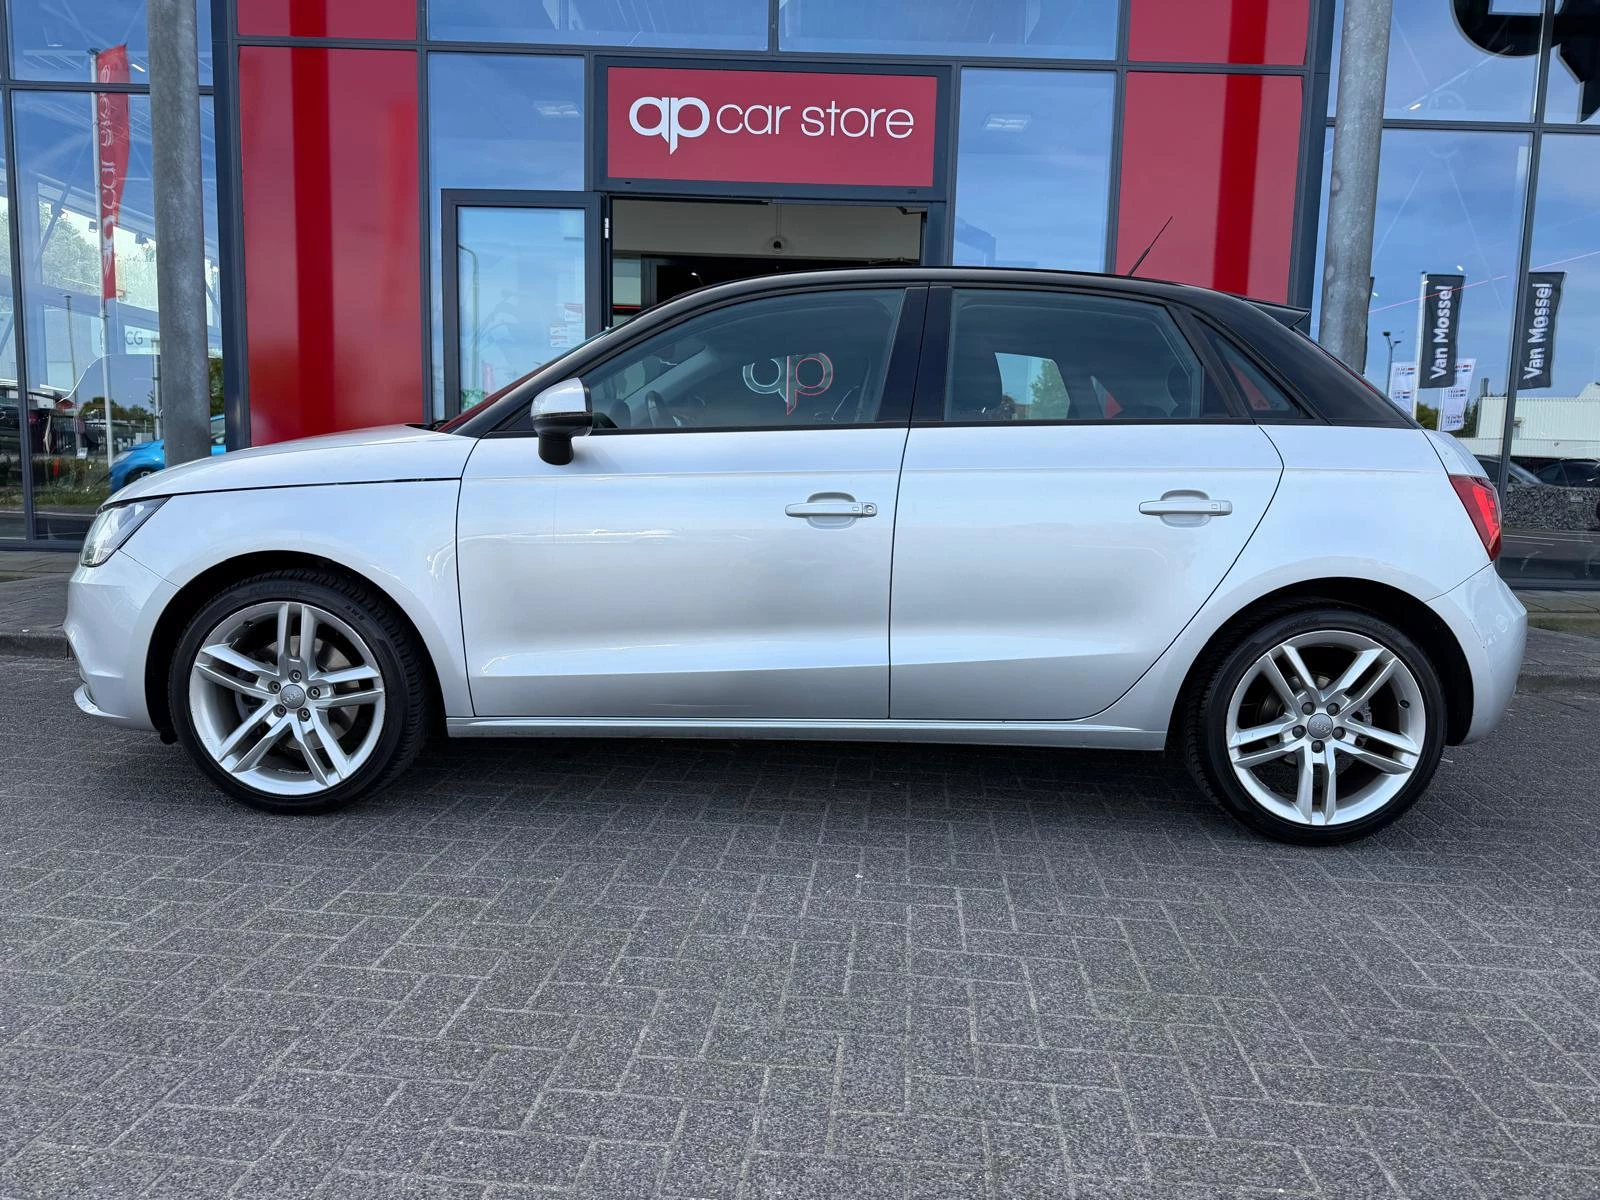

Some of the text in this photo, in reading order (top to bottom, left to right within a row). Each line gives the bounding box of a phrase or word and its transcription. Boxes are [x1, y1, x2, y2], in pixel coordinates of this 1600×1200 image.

[629, 96, 914, 155] ap car store
[1430, 285, 1453, 380] Van Mossel
[1523, 283, 1553, 380] Van Mossel
